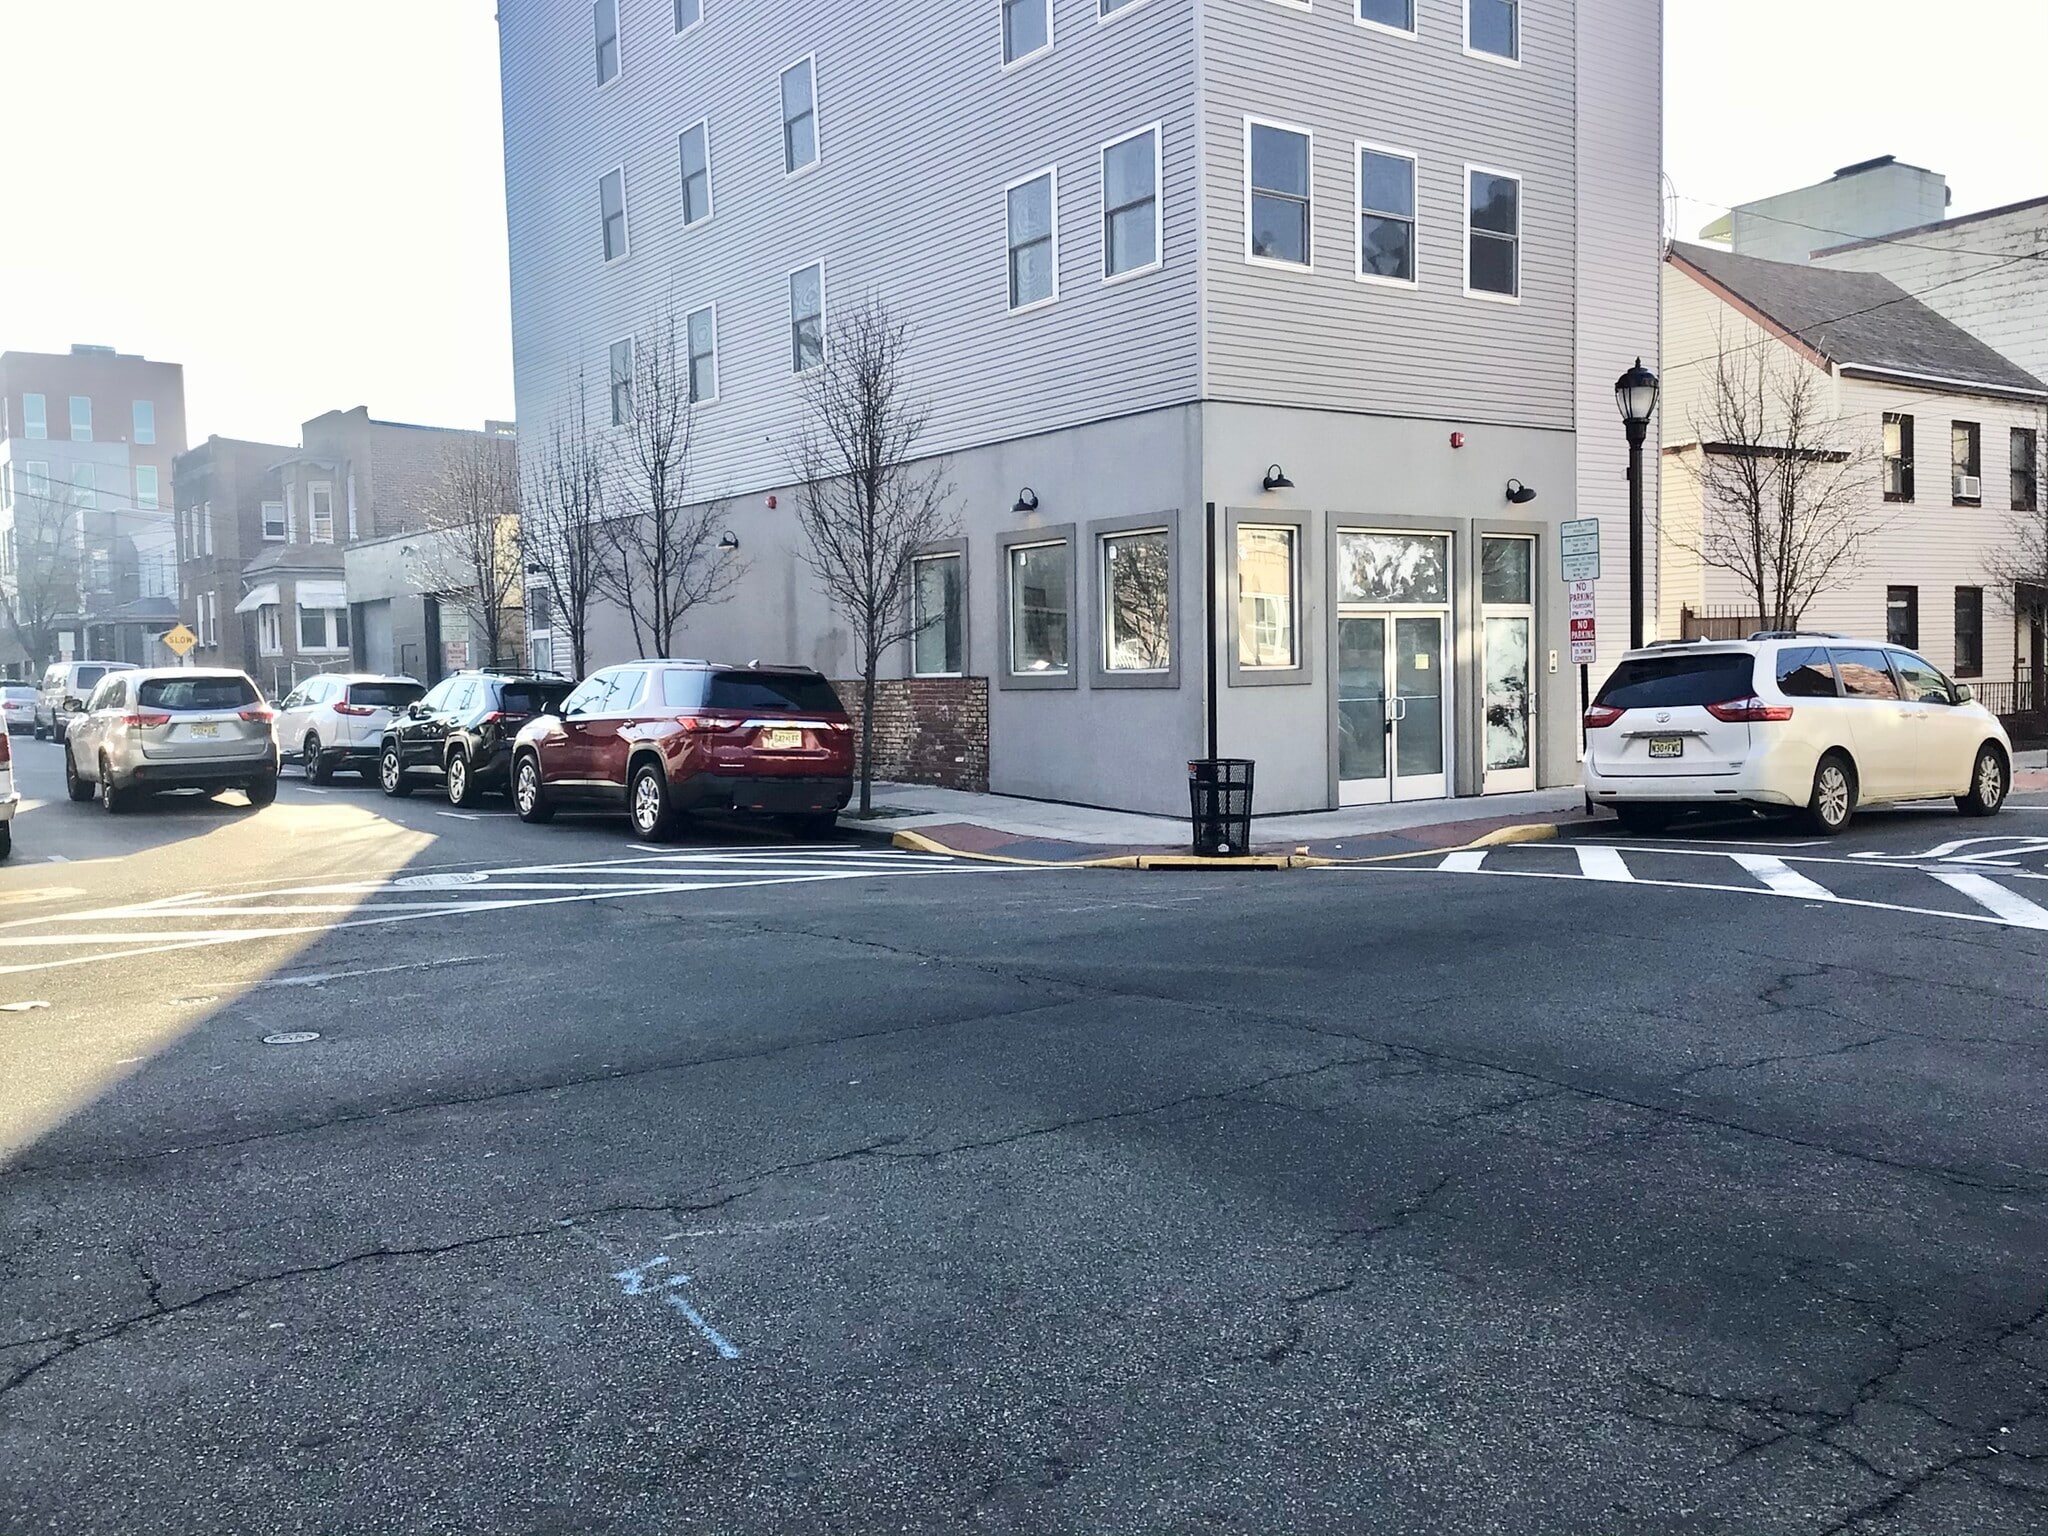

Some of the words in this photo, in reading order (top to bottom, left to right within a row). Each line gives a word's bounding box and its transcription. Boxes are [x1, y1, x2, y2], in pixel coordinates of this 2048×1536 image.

[1576, 582, 1586, 591] NO
[1569, 593, 1594, 602] PARKING
[1577, 620, 1588, 629] NO
[1571, 630, 1594, 639] PARKING
